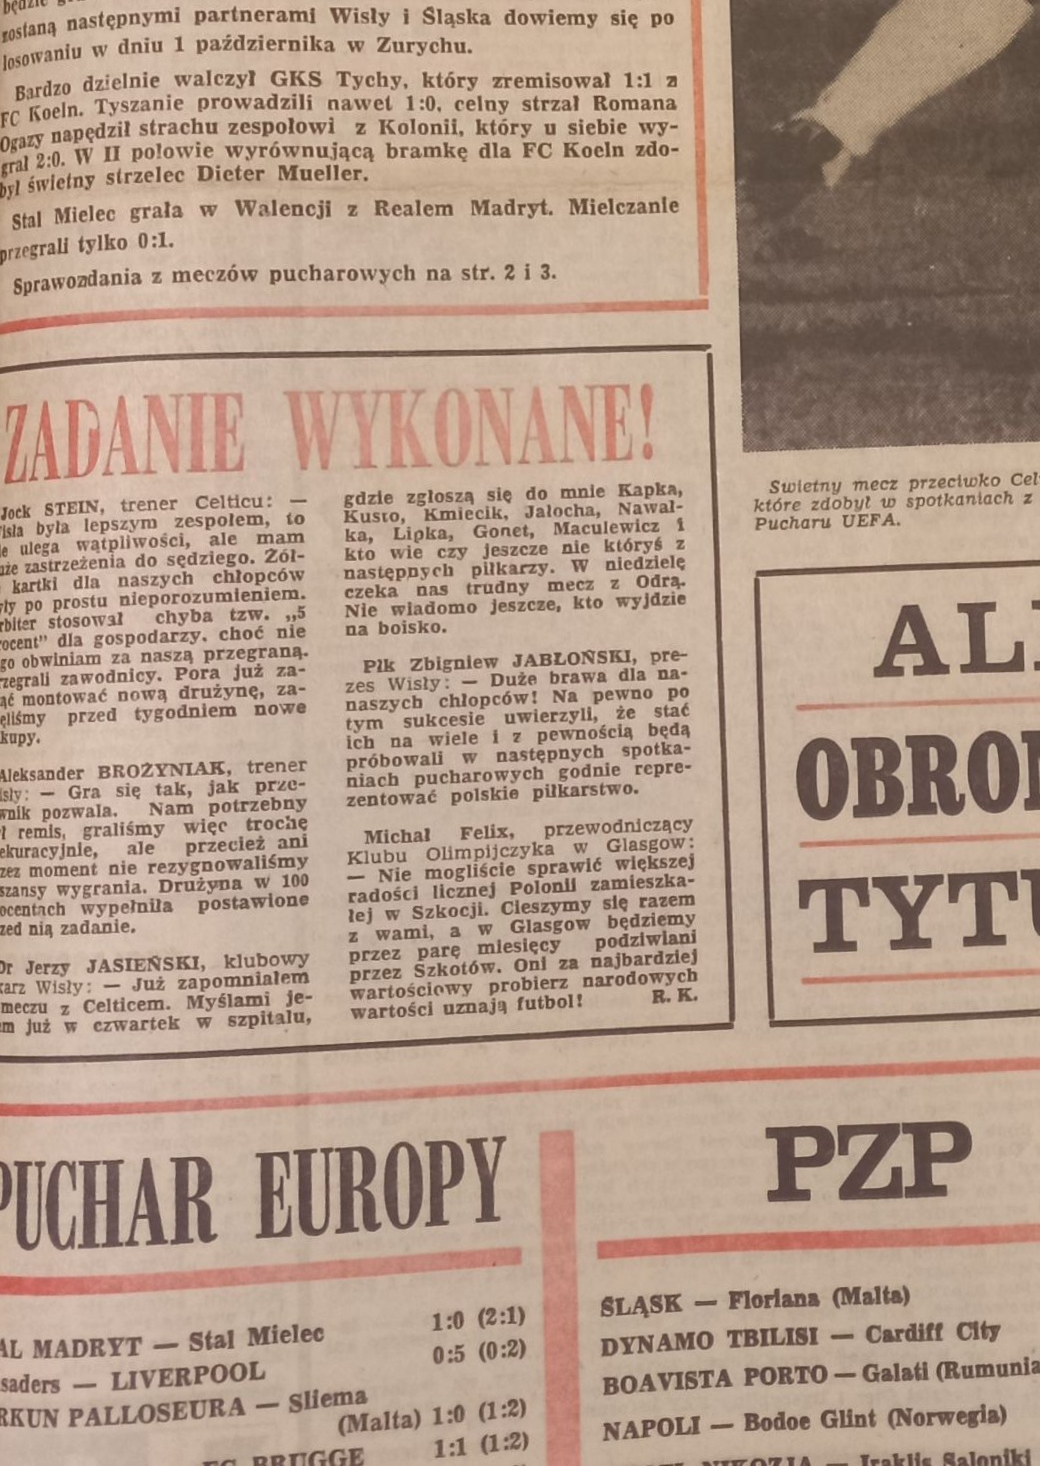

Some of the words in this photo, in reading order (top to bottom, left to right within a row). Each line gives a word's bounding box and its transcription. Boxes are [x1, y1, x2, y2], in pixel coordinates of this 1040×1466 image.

[12, 211, 41, 230] Stal
[54, 205, 115, 224] Mielec
[131, 201, 183, 223] grała
[200, 205, 217, 217] w
[235, 199, 331, 219] Walencji
[348, 205, 357, 216] z
[375, 200, 453, 217] Realem
[569, 196, 679, 215] Mielczanie
[13, 268, 142, 296] Sprawozdania
[152, 272, 162, 284] z
[172, 264, 258, 283] meczów
[269, 263, 416, 286] pucharowych
[427, 268, 451, 281] na
[505, 264, 515, 280] 2
[525, 264, 530, 280] i
[4, 393, 244, 486] ZADANIE
[283, 383, 654, 471] WYKONANE!
[853, 480, 898, 491] mecz
[909, 473, 1001, 492] przeciwko
[1, 505, 30, 521] Jock
[121, 499, 178, 512] trener
[196, 494, 272, 509] Celticu:
[98, 761, 232, 779] BROŻYNIAK,
[247, 760, 307, 774] trener
[364, 828, 430, 844] Michał
[544, 818, 693, 841] przewodniczący
[765, 1121, 972, 1202] PZP
[255, 1136, 506, 1239] EUROPY
[729, 1288, 820, 1309] Floriana
[832, 1285, 910, 1309] (Malta)
[33, 1337, 142, 1358] MADRYT
[189, 1330, 234, 1351] Stal
[248, 1324, 324, 1346] Mielec
[433, 1311, 464, 1331] 1:0
[478, 1306, 525, 1329] (2:1)
[601, 1331, 714, 1357] DYNAMO
[727, 1327, 818, 1348] TBILISI
[866, 1322, 943, 1343] Cardiff
[957, 1321, 1001, 1342] City
